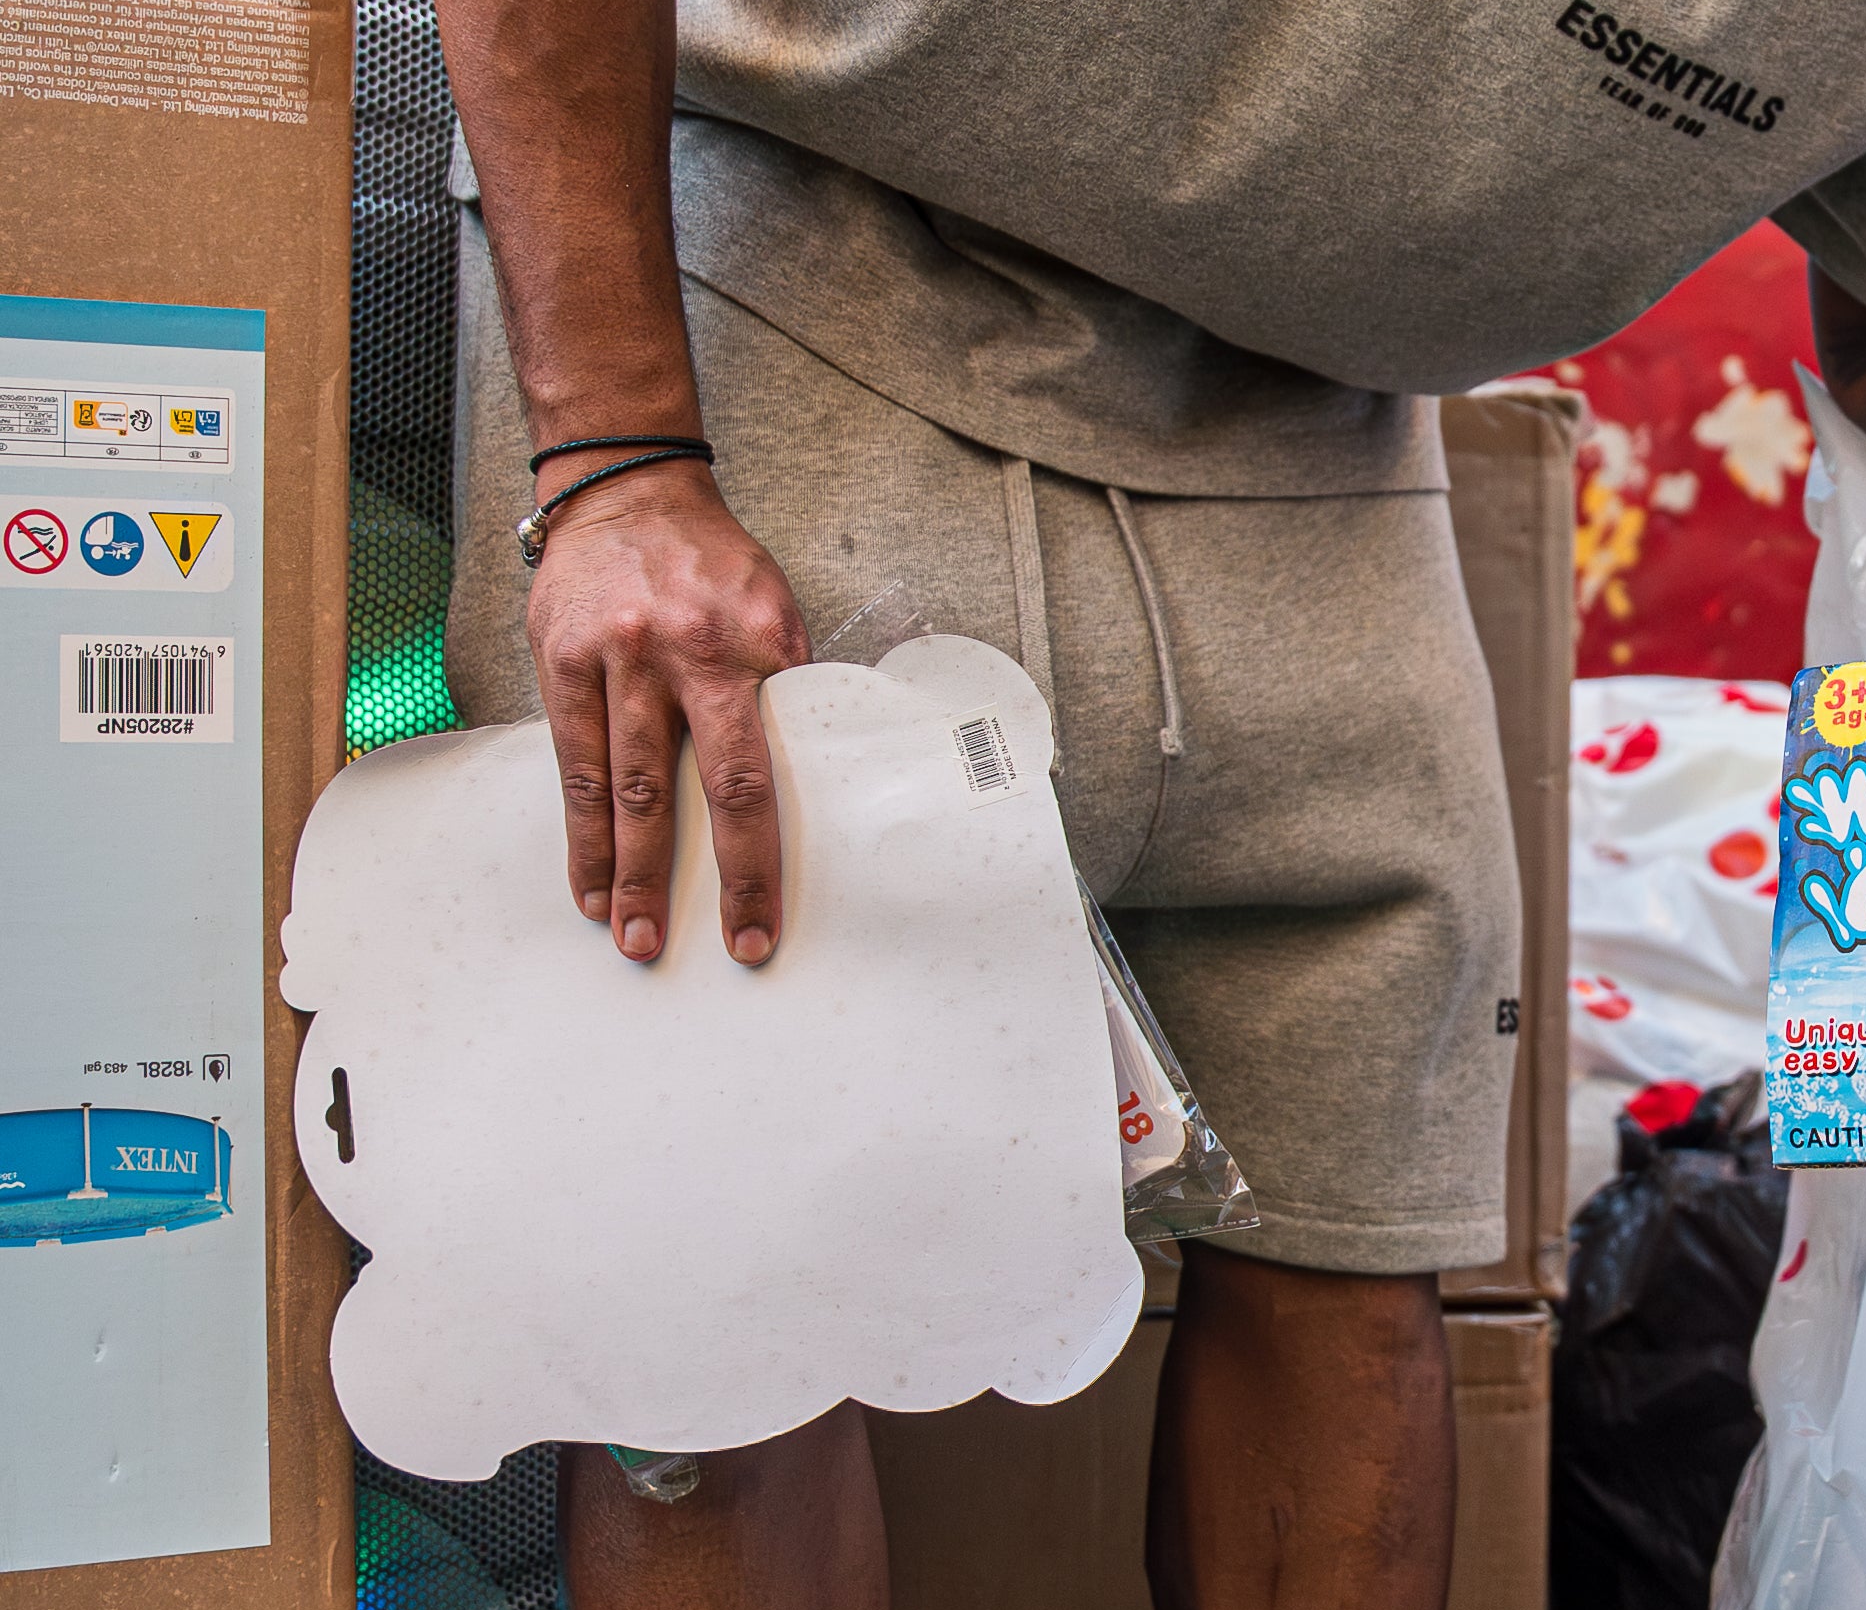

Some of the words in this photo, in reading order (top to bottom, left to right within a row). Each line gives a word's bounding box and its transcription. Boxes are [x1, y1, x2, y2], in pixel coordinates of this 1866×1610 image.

[89, 2, 112, 13] und
[115, 4, 131, 15] für
[8, 6, 96, 25] commercialisé
[99, 16, 111, 27] et
[134, 5, 222, 25] por/Hergestellt
[23, 20, 103, 39] Development
[114, 16, 142, 30] pour
[145, 19, 214, 38] by/Fabriqué
[226, 15, 273, 31] Europea
[277, 22, 309, 35] Unión
[45, 36, 70, 49] Tutti
[107, 30, 135, 42] Intex
[219, 29, 252, 42] Union
[255, 31, 309, 48] European
[123, 44, 158, 58] Lizenz
[202, 40, 223, 52] Ltd.
[227, 41, 280, 58] Marketing
[26, 46, 70, 62] algunos
[74, 52, 88, 63] en
[162, 48, 171, 59] in
[174, 50, 199, 62] Welt
[201, 53, 220, 64] der
[18, 60, 49, 72] world
[91, 54, 143, 69] utilizadas
[146, 58, 207, 75] registradas
[224, 55, 268, 69] Ländern
[271, 58, 308, 73] einigen
[54, 63, 70, 75] the
[74, 65, 86, 76] of
[89, 67, 140, 82] countries
[209, 66, 268, 82] de/Marcas
[37, 75, 52, 86] los
[144, 72, 174, 85] some
[177, 76, 186, 86] in
[189, 77, 216, 89] used
[271, 73, 308, 86] licence
[17, 85, 40, 99] Co.,
[57, 77, 143, 95] réservés/Todos
[146, 86, 178, 98] droits
[219, 80, 283, 96] Trademarks
[44, 86, 118, 106] Development
[121, 95, 148, 109] Intex
[181, 89, 259, 106] reserved/Tous
[262, 95, 292, 109] rights
[1600, 75, 1646, 110] FEAR
[1646, 103, 1673, 122] OF
[160, 99, 181, 112] Ltd.
[184, 100, 239, 118] Marketing
[294, 100, 308, 111] All
[242, 107, 268, 121] Intex
[84, 642, 143, 657] 420561
[151, 643, 208, 657] 941057
[97, 717, 194, 735] #28205NP
[991, 716, 1005, 744] CHINA
[1000, 745, 1008, 755] IN
[1004, 756, 1017, 780] MADE
[102, 1061, 128, 1075] 483
[1784, 1048, 1861, 1074] easy
[83, 1061, 101, 1076] gal
[137, 1060, 193, 1078] 1828L
[115, 1146, 198, 1174] INTEX
